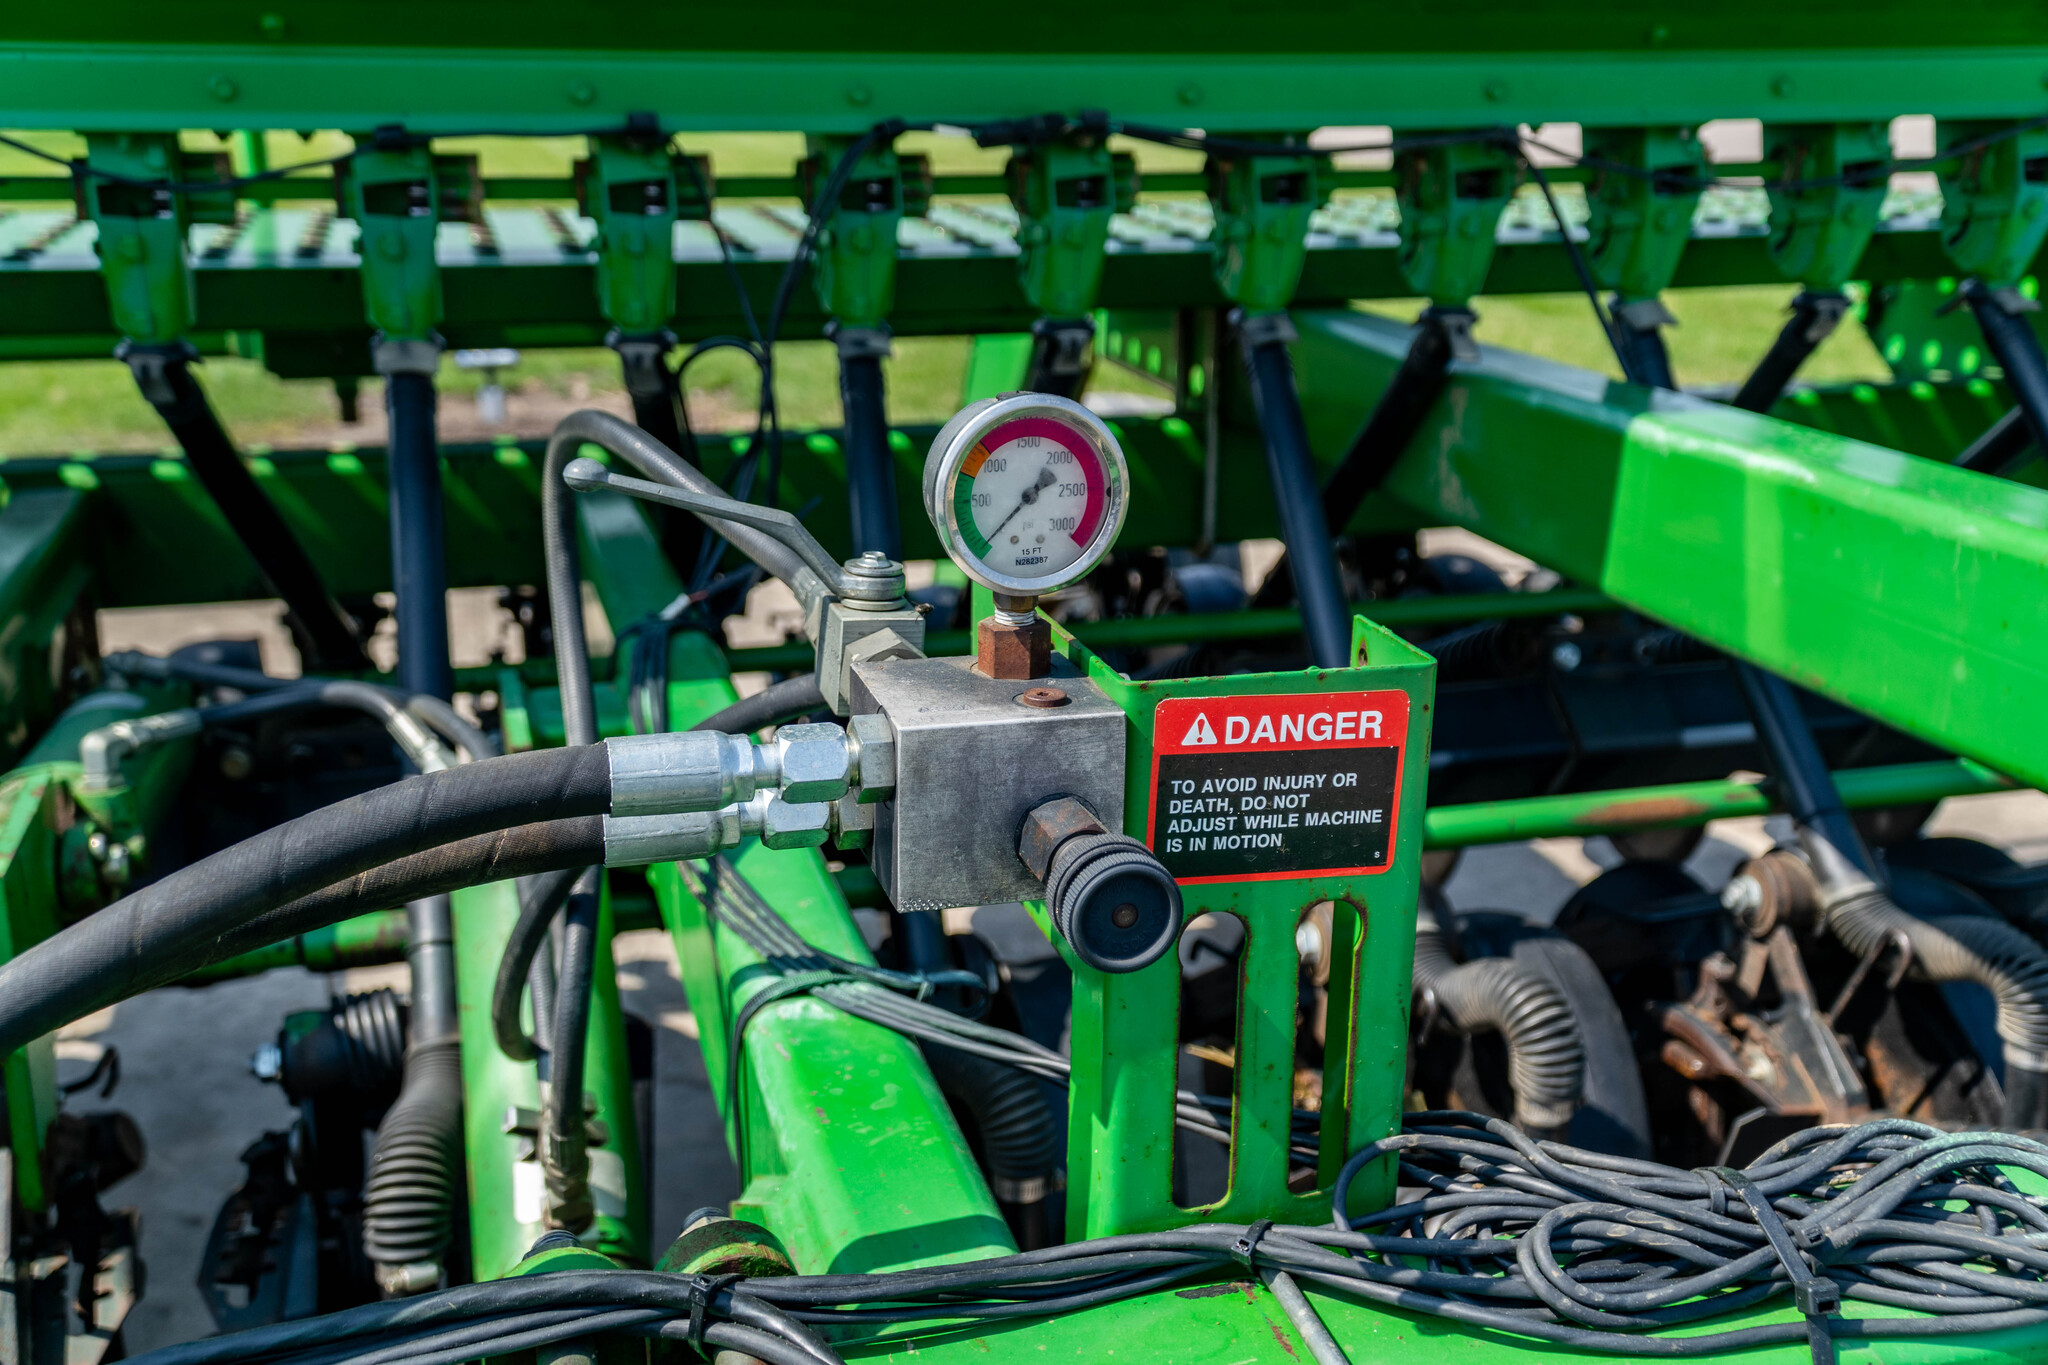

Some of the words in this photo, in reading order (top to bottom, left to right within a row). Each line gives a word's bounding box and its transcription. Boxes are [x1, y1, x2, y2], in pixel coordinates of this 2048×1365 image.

[1017, 436, 1040, 448] 1500
[1046, 451, 1073, 464] 2000
[984, 459, 1007, 473] 1000
[1059, 484, 1085, 497] 2500
[972, 494, 991, 507] 500
[1049, 518, 1075, 531] 3000
[1224, 710, 1383, 745] DANGER
[1171, 780, 1196, 794] TO
[1201, 777, 1257, 793] AVOID
[1263, 774, 1326, 791] INJURY
[1332, 773, 1358, 787] OR
[1169, 798, 1234, 814] DEATH,
[1241, 796, 1267, 811] DO
[1273, 794, 1310, 809] NOT
[1168, 816, 1237, 834] ADJUST
[1244, 814, 1299, 830] WHILE
[1305, 809, 1383, 826] MACHINE
[1166, 838, 1182, 852] IS
[1189, 837, 1207, 851] IN
[1213, 834, 1283, 850] MOTION
